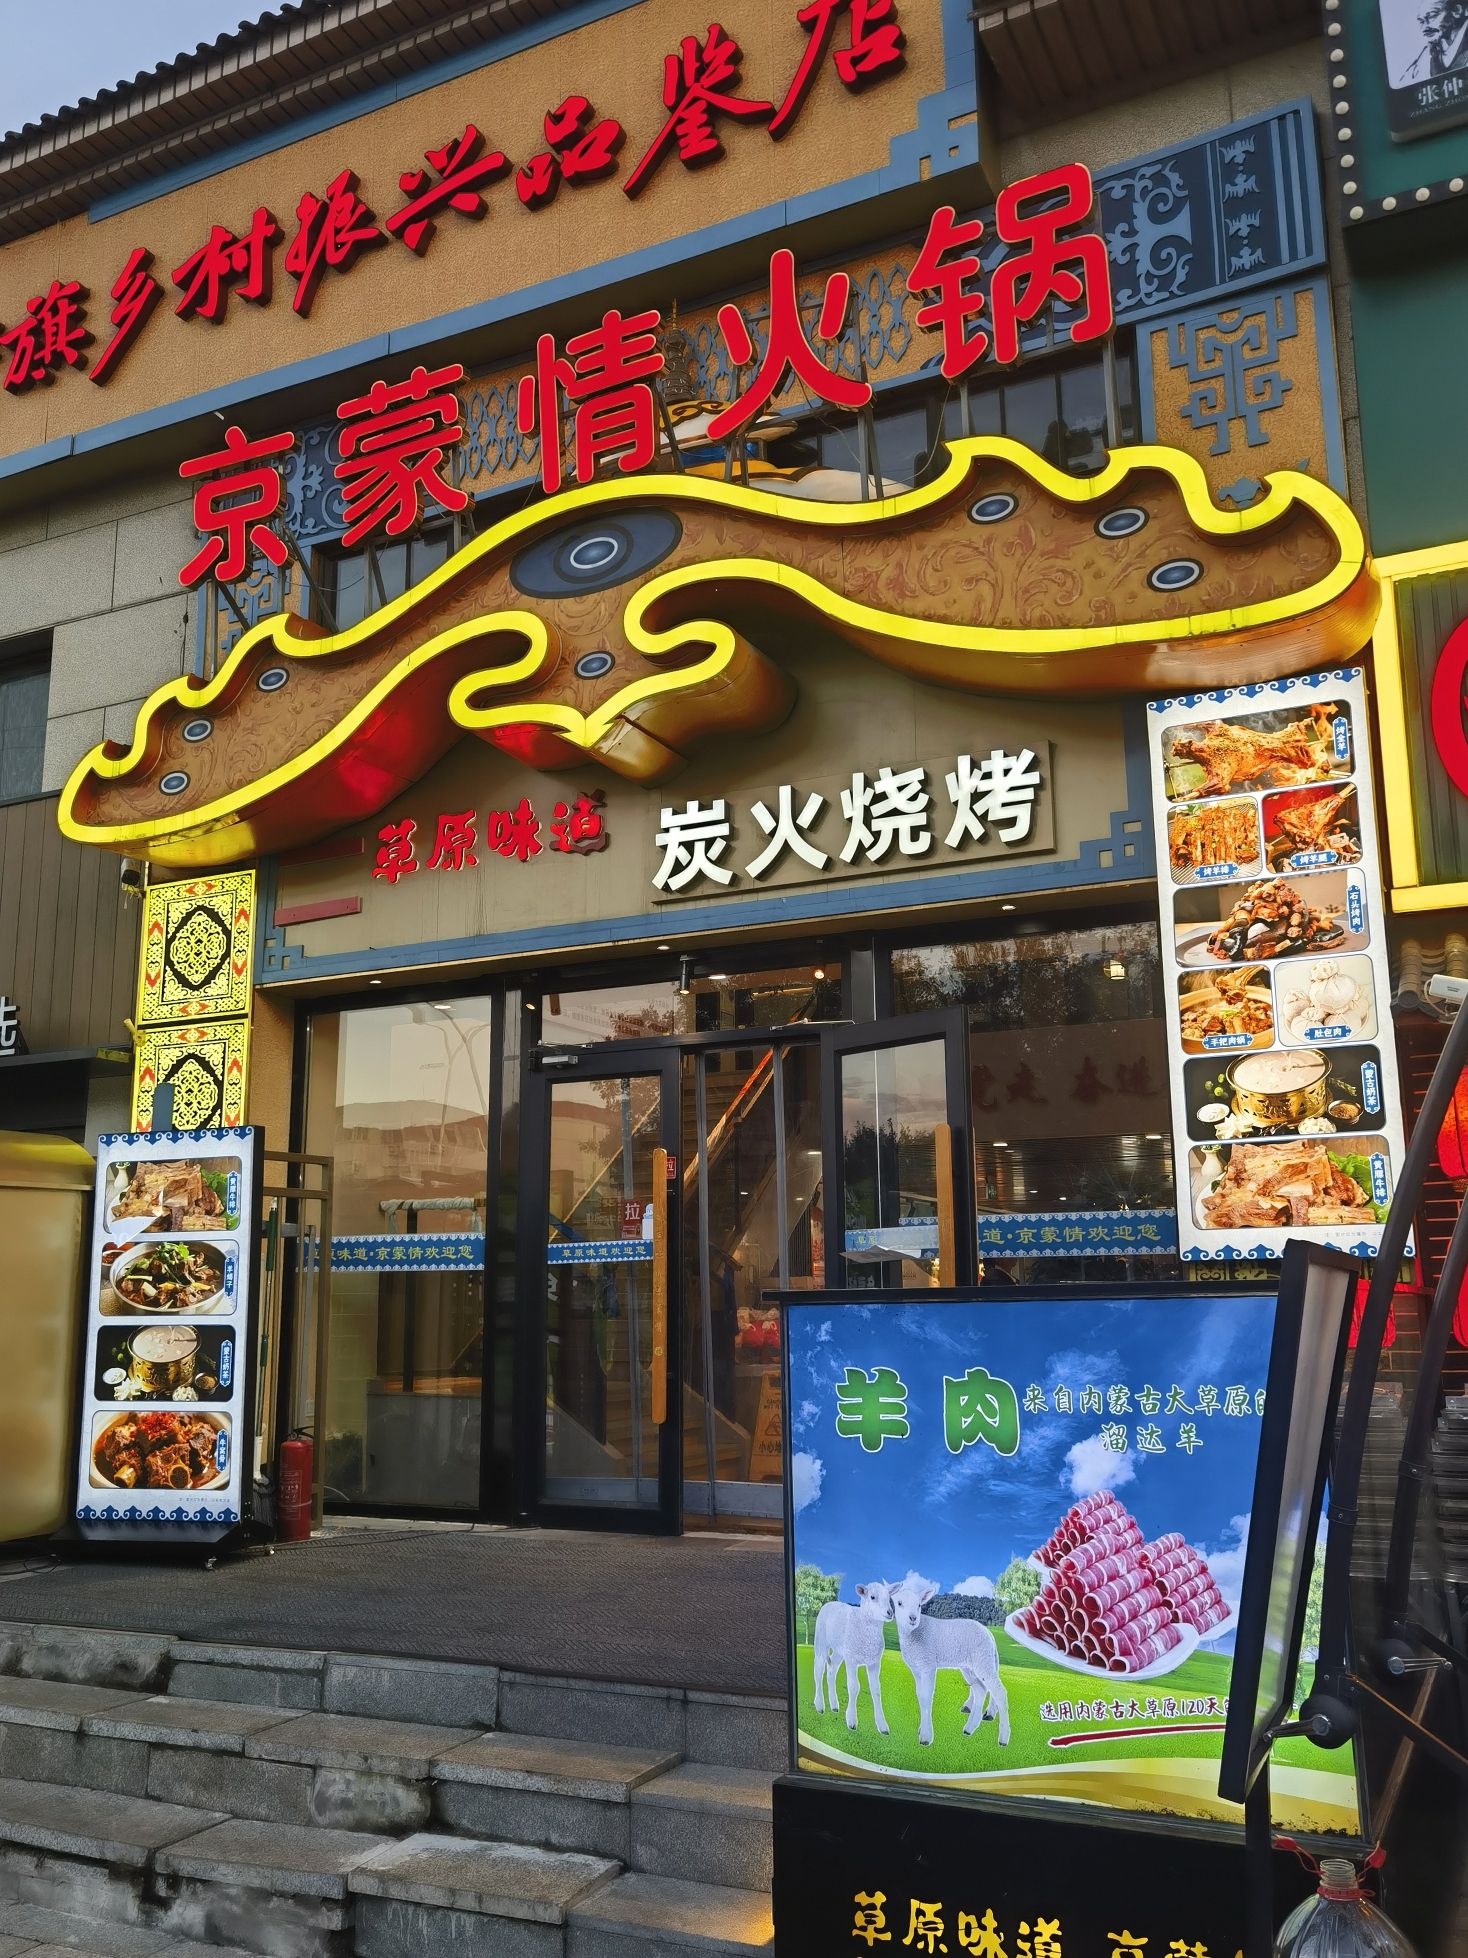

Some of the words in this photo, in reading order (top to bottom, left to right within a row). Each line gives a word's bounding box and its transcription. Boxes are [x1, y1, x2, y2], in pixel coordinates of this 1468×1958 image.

[0, 0, 902, 390] 旗乡村振兴品鉴店
[179, 162, 1114, 587] 京蒙情火锅
[651, 748, 1042, 892] 炭火烧烤
[371, 790, 609, 885] 草原味道
[1349, 891, 1361, 926] 石头烤肉
[1210, 1037, 1246, 1047] 手把肉锅
[1314, 1027, 1342, 1038] 肚包肉
[1364, 1069, 1376, 1106] 蒙古奶茶
[625, 1202, 641, 1220] 拉
[562, 1246, 647, 1257] 草原味道欢迎您
[979, 1224, 1161, 1245] 道·京蒙情欢迎您
[222, 1346, 230, 1379] 蒙古奶茶
[1100, 1422, 1204, 1455] 溜达羊
[851, 1890, 1063, 1958] 草原味道
